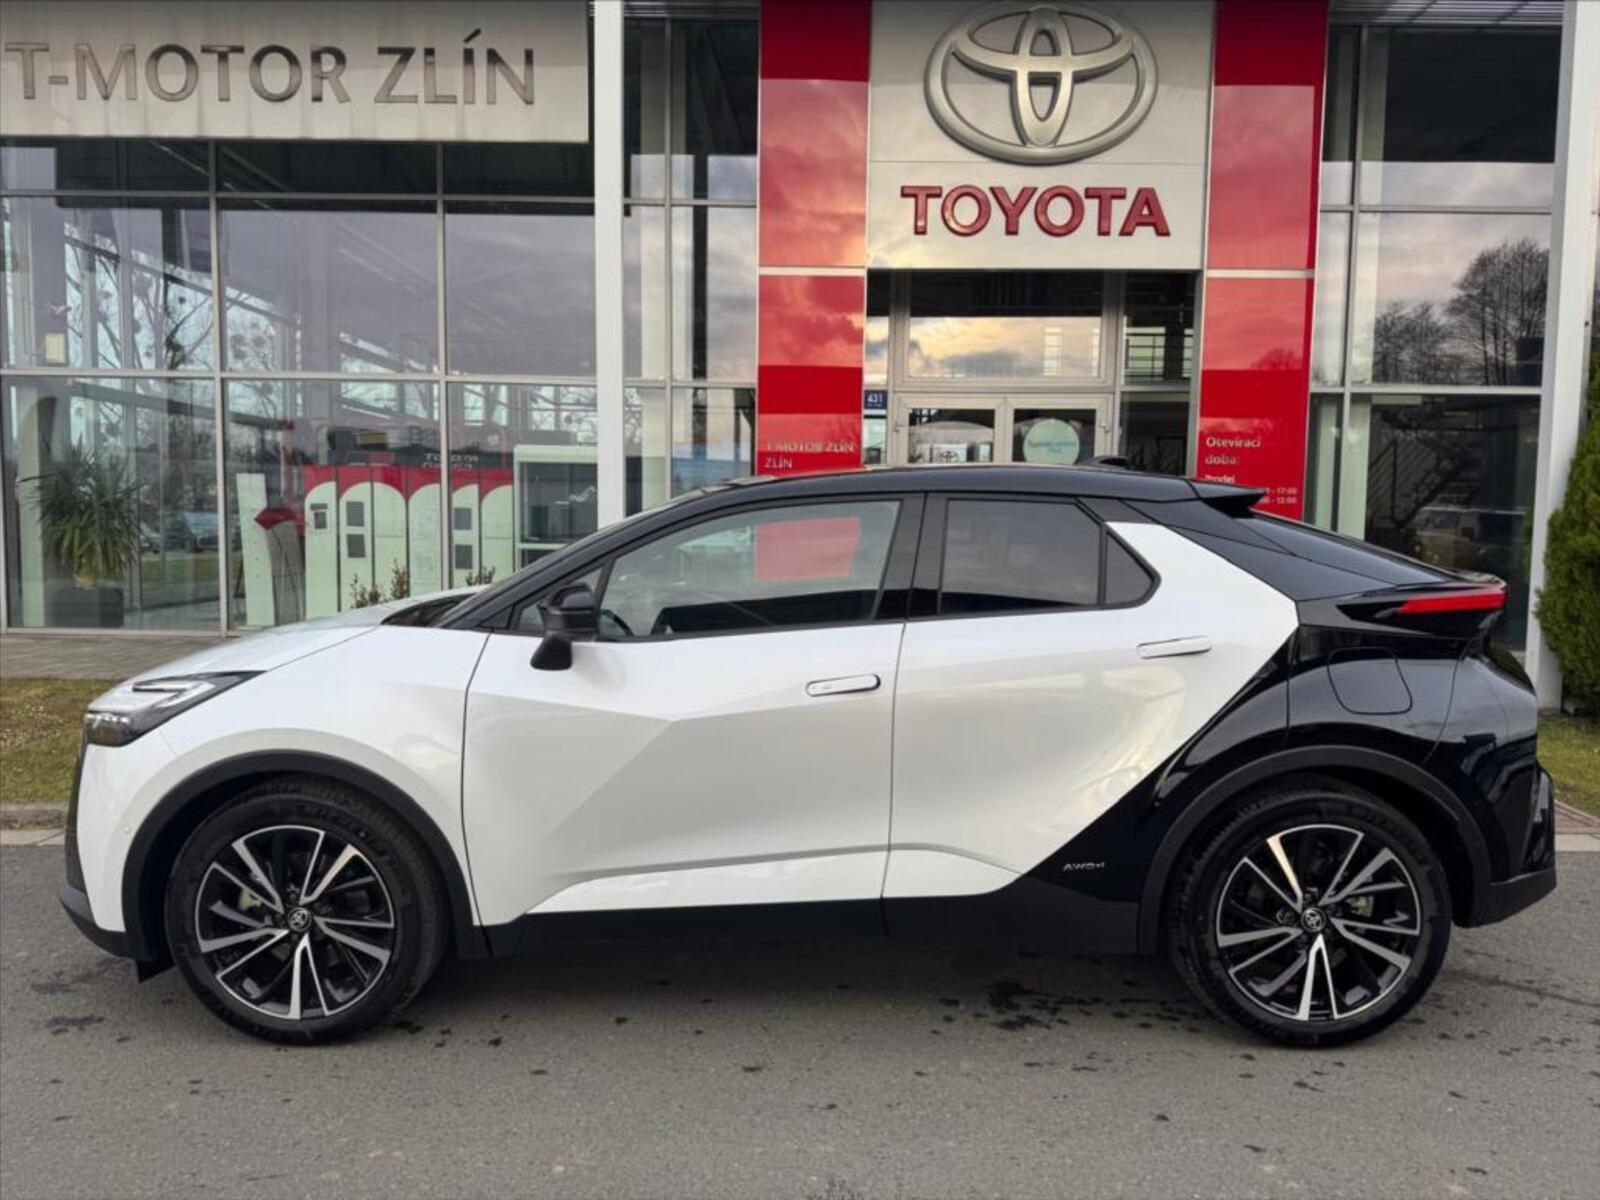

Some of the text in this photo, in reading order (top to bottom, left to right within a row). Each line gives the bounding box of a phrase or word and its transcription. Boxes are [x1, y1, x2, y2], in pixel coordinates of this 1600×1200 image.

[5, 28, 535, 105] T-MOTOR ZLÍN
[900, 184, 1171, 237] TOYOTA
